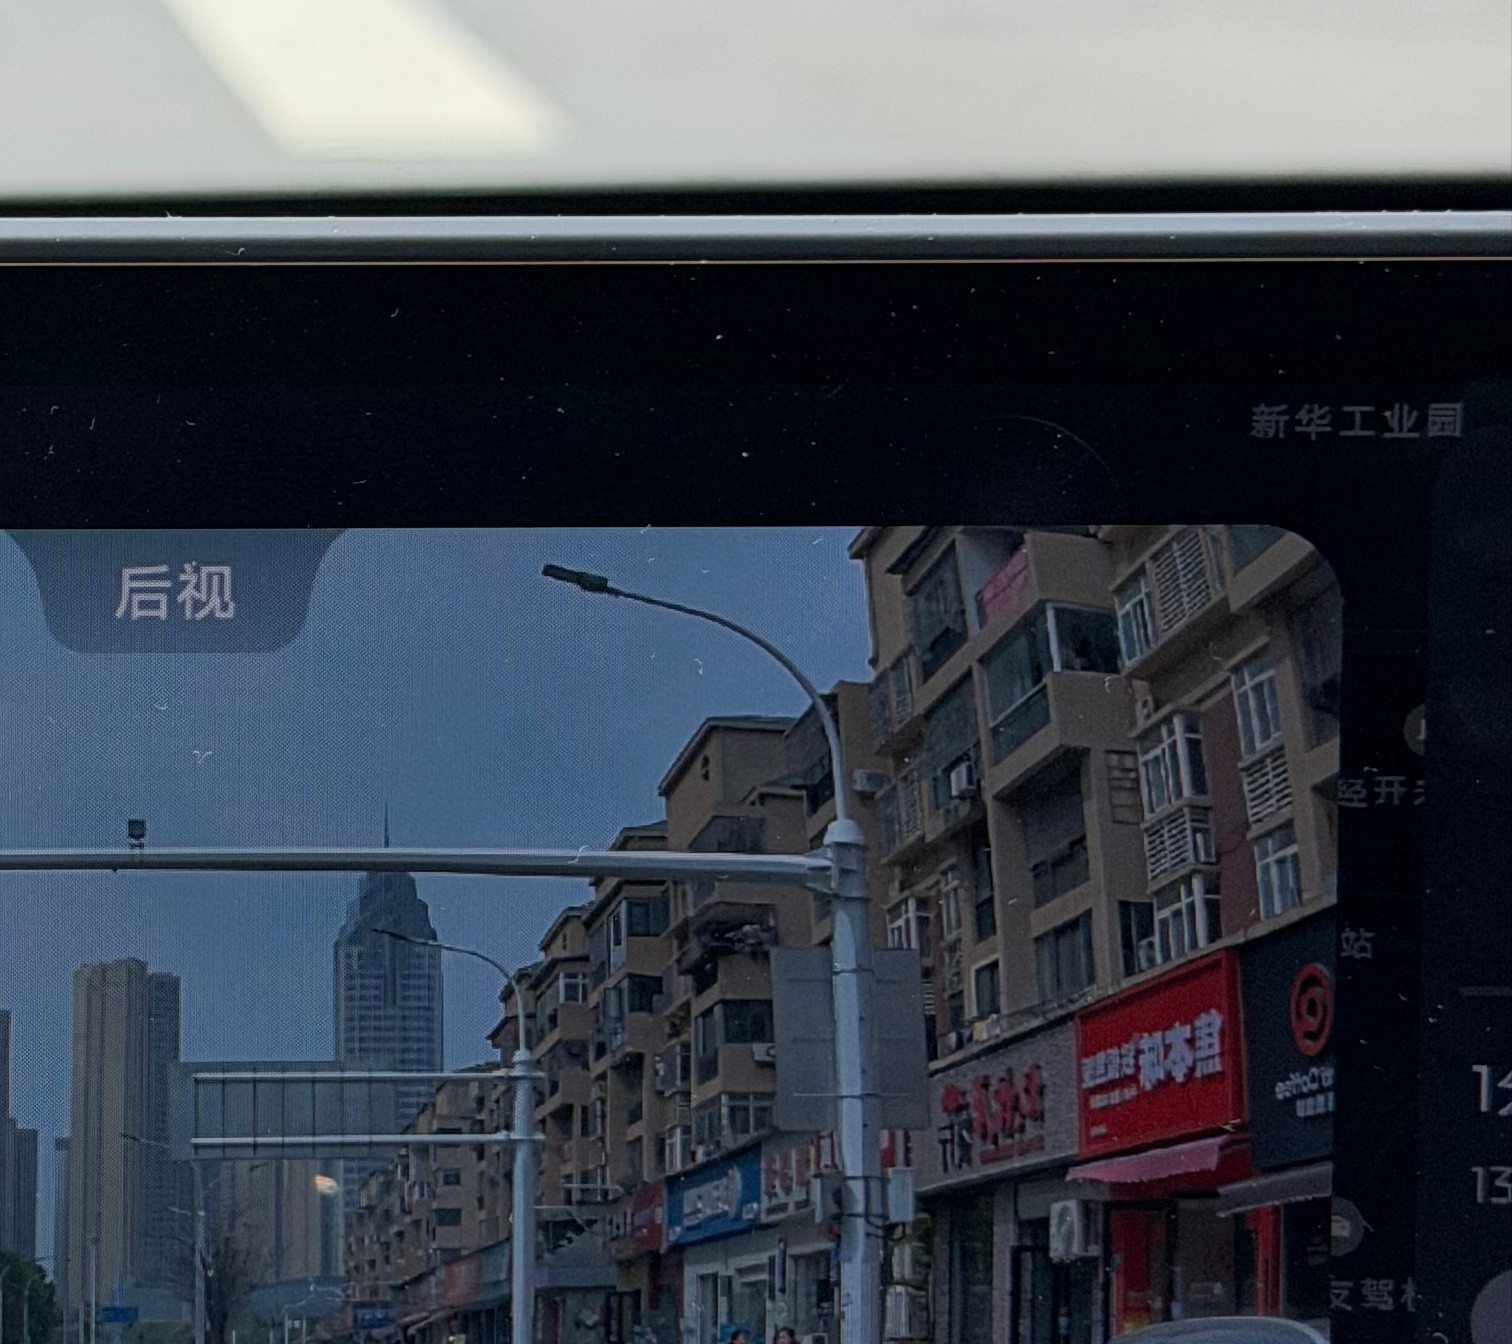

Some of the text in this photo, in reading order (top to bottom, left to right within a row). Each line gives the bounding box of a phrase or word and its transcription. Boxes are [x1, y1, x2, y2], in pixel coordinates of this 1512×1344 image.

[1248, 402, 1464, 441] 新华工业园
[114, 560, 236, 621] 后视
